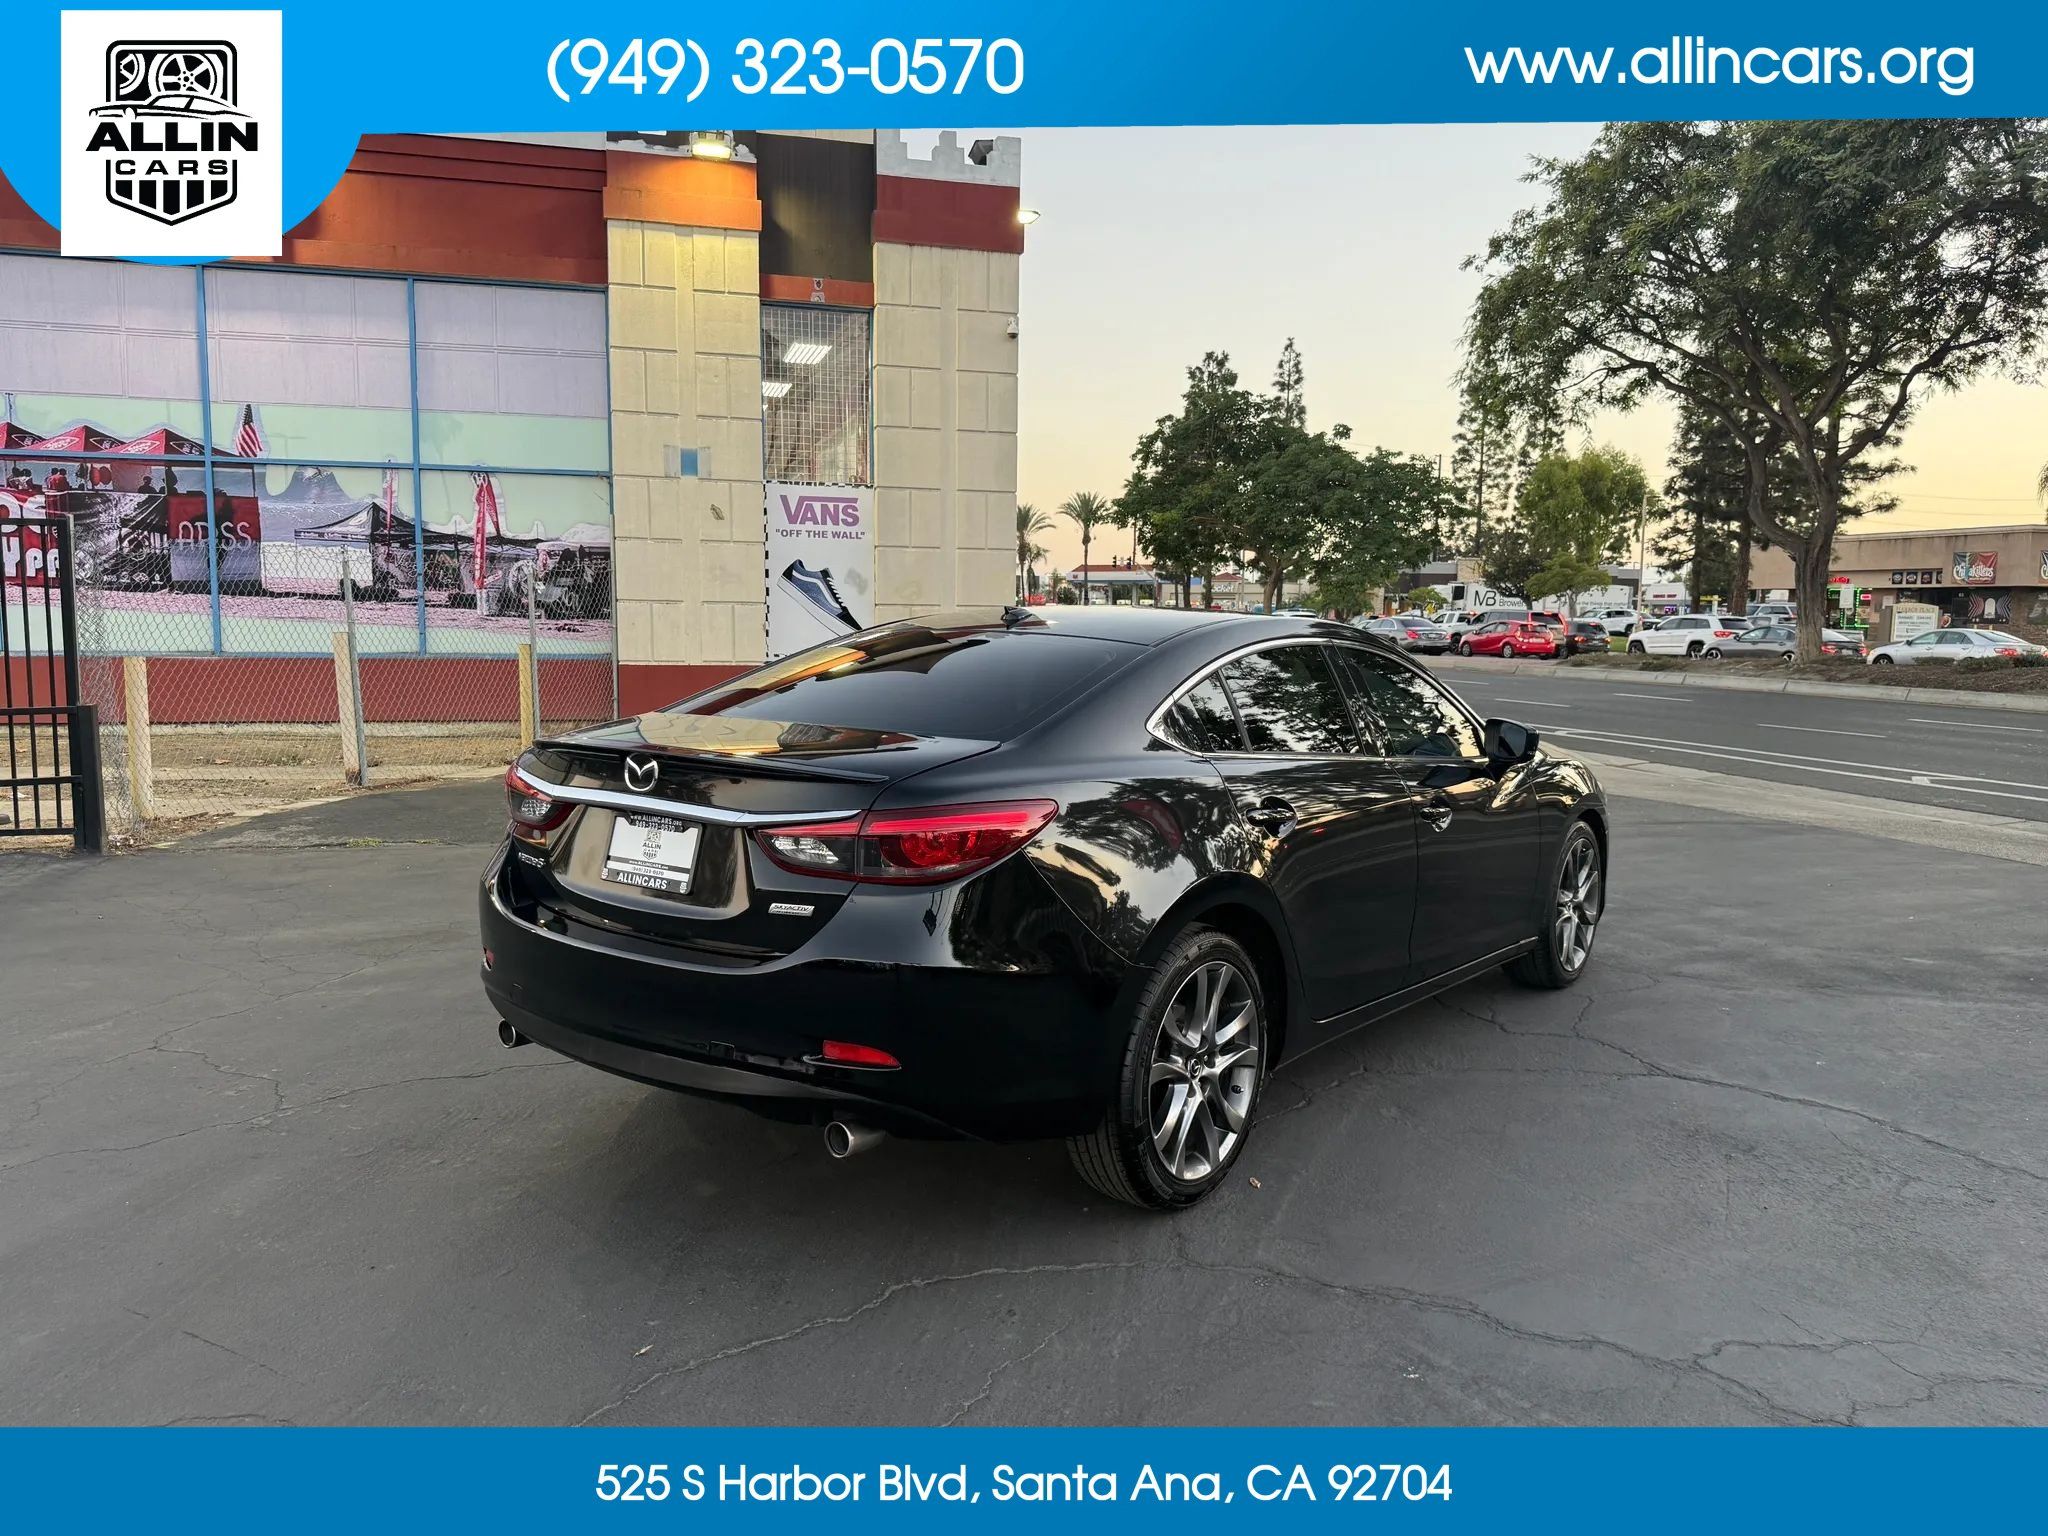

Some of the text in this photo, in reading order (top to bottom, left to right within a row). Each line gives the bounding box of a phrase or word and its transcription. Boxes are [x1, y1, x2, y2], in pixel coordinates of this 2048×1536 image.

[780, 494, 860, 528] VANS
[775, 528, 865, 540] "OFF THE WALL"
[617, 872, 668, 889] ALLINCARS
